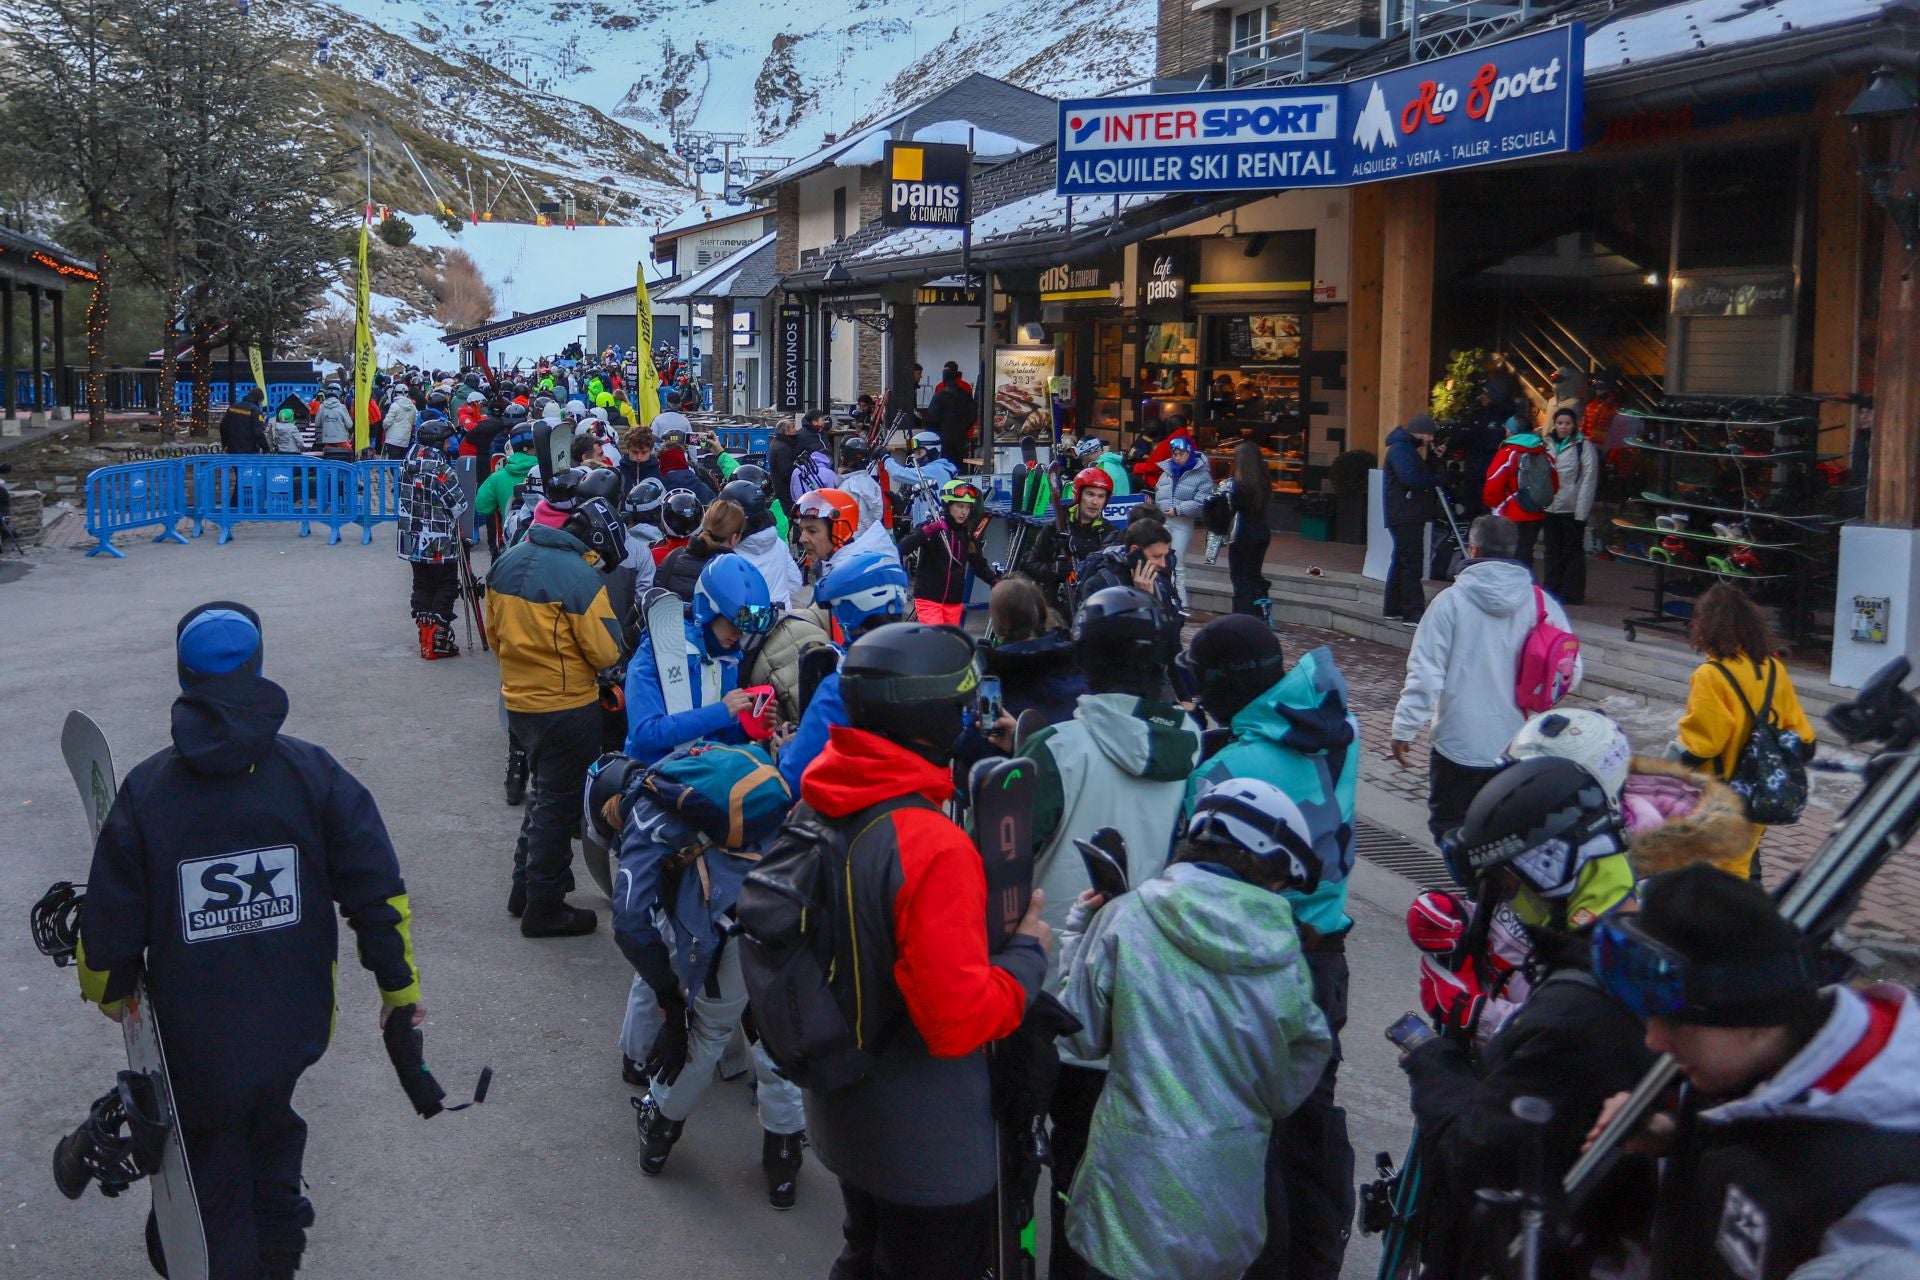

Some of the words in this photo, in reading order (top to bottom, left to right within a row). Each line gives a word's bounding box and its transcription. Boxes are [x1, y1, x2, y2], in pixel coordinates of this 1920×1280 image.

[1401, 80, 1459, 134] Rio
[1466, 57, 1561, 123] Sport
[1064, 156, 1182, 185] ALQUILER
[1189, 154, 1228, 180] SKI
[1237, 150, 1336, 178] RENTAL
[1352, 157, 1398, 177] ALQUILER
[1406, 150, 1441, 168] VENTA
[1451, 140, 1490, 159] TALLER
[1501, 129, 1557, 151] ESCUELA
[891, 182, 959, 213] pans
[910, 206, 917, 221] &
[918, 206, 959, 223] COMPANY
[699, 238, 757, 247] sierranevad
[1039, 264, 1069, 292] ans
[1147, 280, 1177, 304] pans
[786, 323, 797, 406] DESAYUNOS
[193, 898, 291, 930] SOUTHSTAR
[226, 920, 263, 933] PROFESOR
